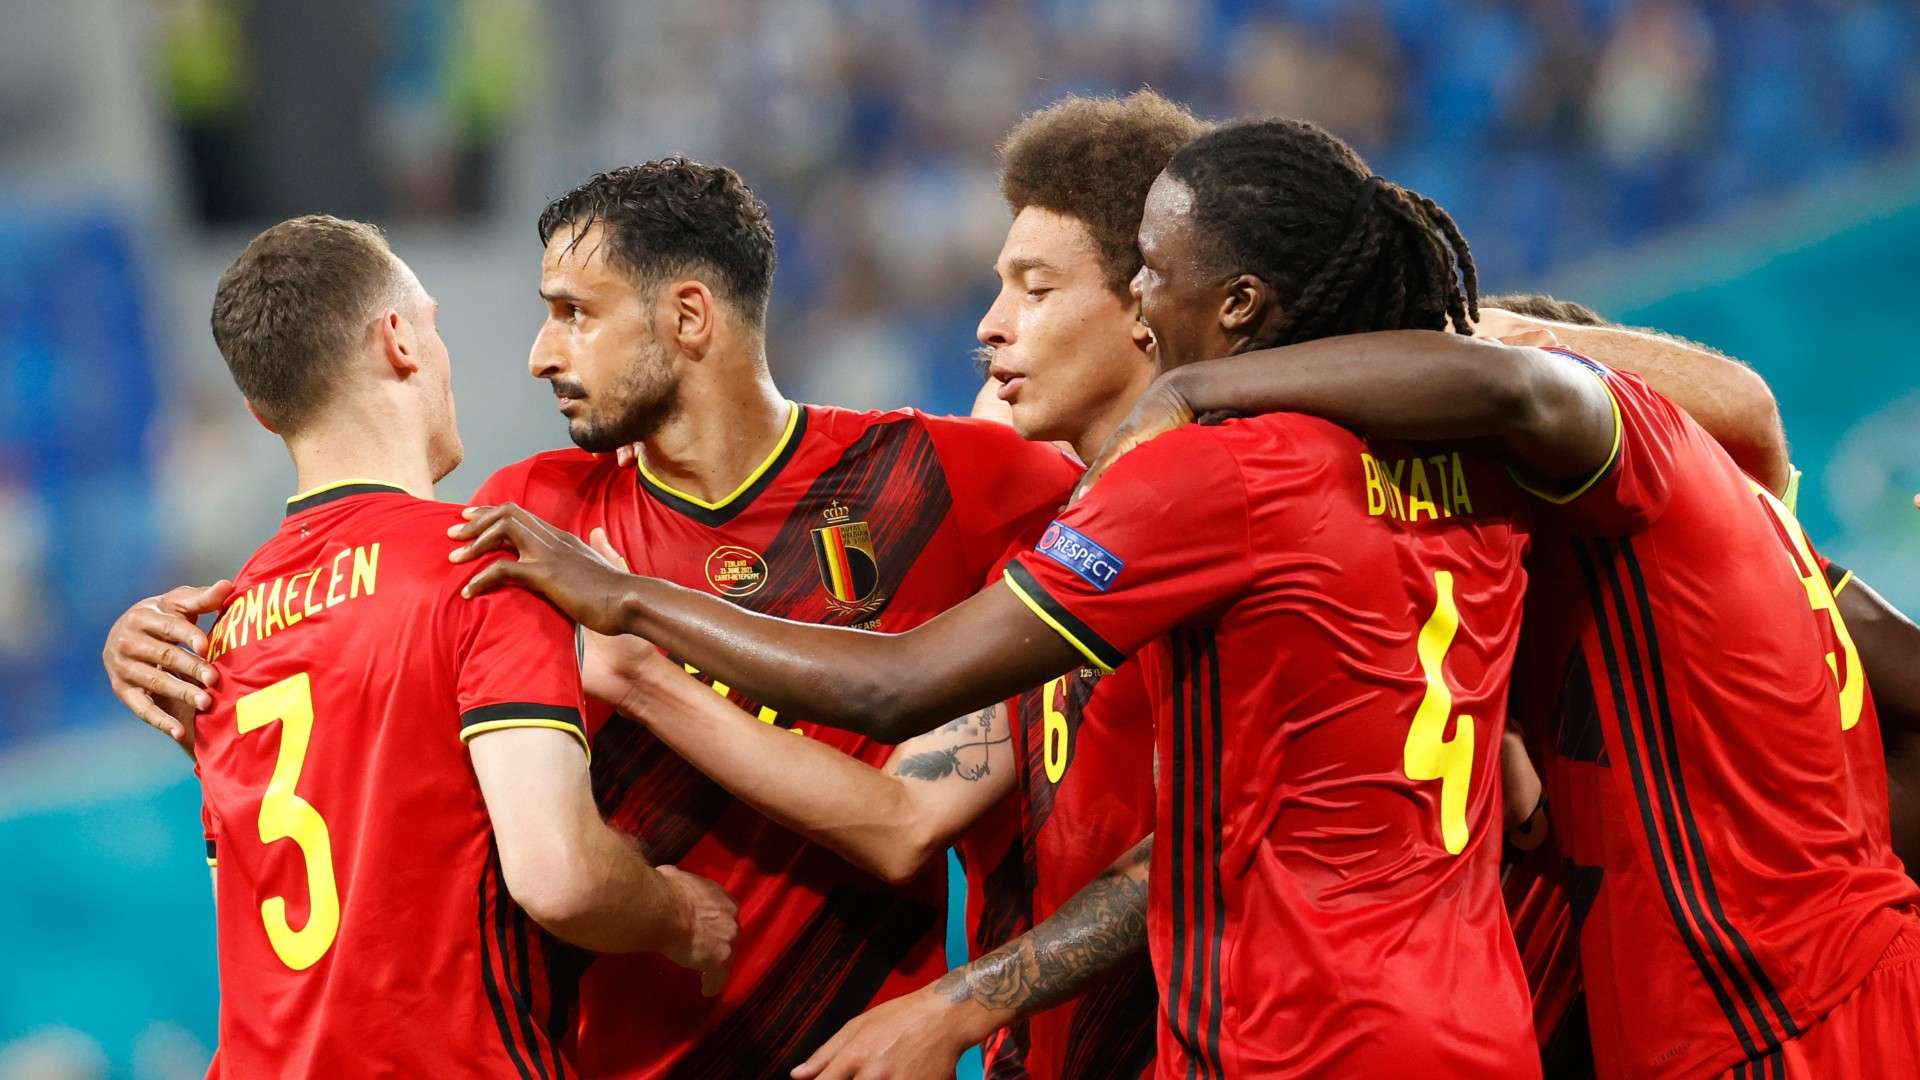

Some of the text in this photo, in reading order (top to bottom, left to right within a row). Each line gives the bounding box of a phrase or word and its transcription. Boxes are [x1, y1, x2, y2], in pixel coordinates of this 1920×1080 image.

[1053, 535, 1118, 582] RESPECT
[1080, 669, 1092, 678] 125
[1403, 570, 1475, 856] 4
[1043, 674, 1069, 784] 6
[235, 671, 340, 971] 3
